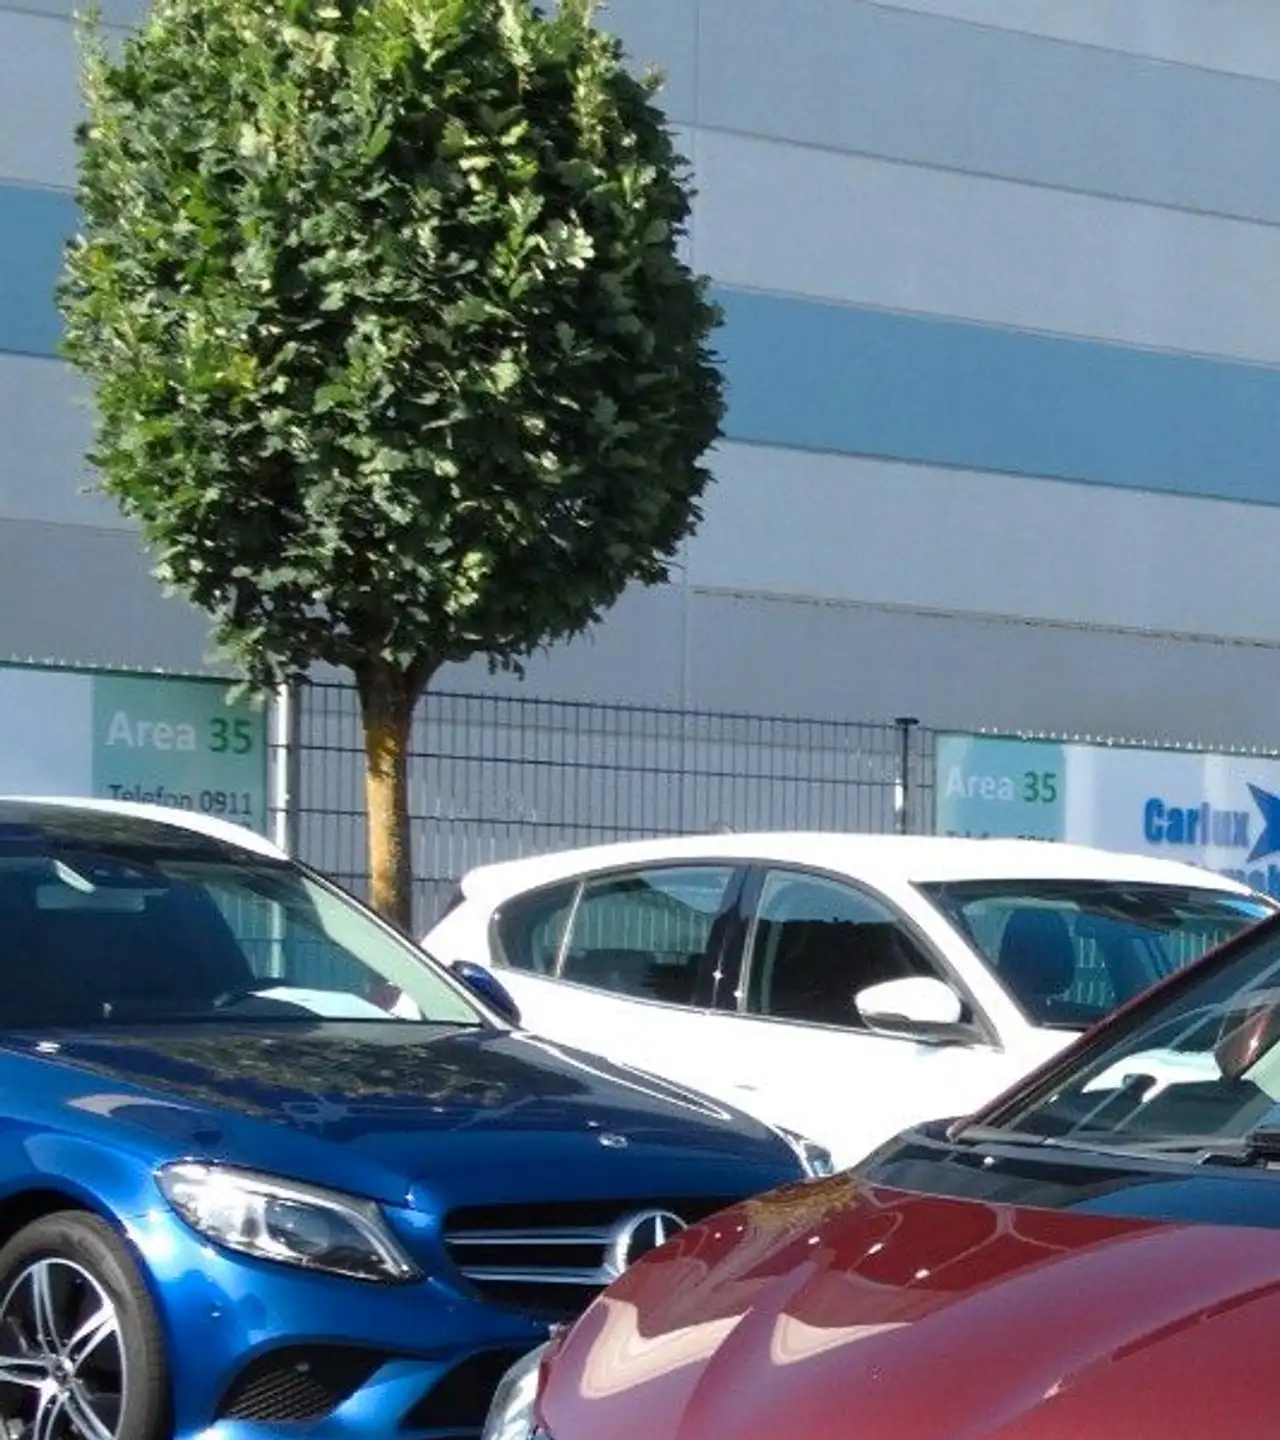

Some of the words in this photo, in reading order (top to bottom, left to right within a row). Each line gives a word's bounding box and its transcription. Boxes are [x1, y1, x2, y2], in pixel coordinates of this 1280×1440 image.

[104, 710, 197, 751] Area
[208, 716, 253, 755] 35
[200, 789, 254, 815] 0911
[946, 766, 1015, 801] Area
[1023, 770, 1058, 804] 35
[1143, 797, 1250, 848] Carlux
